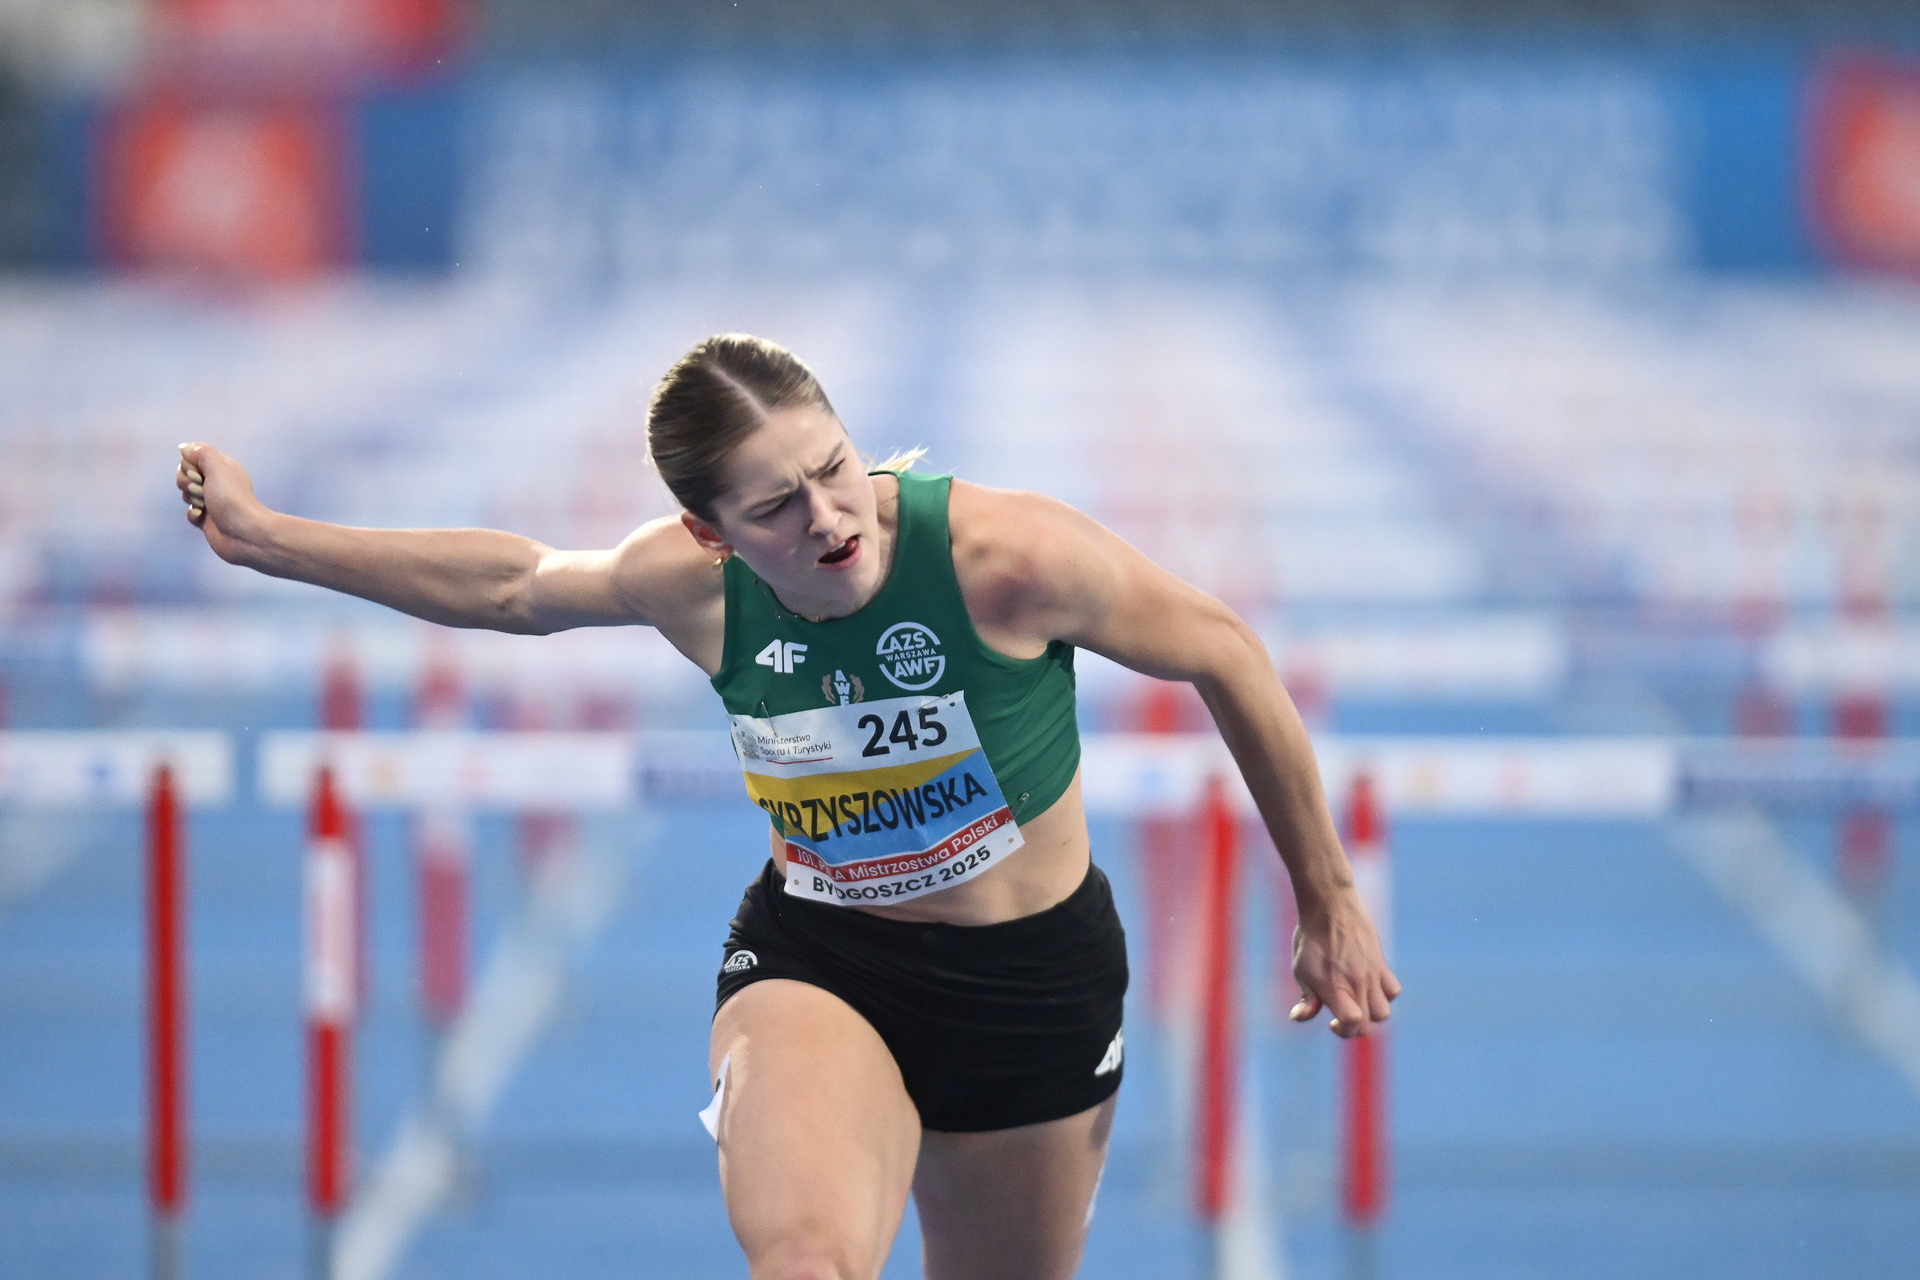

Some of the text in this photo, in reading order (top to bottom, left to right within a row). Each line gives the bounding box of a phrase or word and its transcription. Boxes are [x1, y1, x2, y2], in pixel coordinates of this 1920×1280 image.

[889, 631, 926, 651] AZS
[755, 639, 808, 674] 4F
[885, 648, 937, 662] WARSZAWA
[894, 656, 936, 678] AWF
[757, 734, 811, 745] Ministerstwo
[857, 706, 948, 758] 245
[793, 741, 832, 754] Turystyki
[848, 847, 951, 880] Mistrzostwa
[951, 814, 999, 851] Polski
[813, 845, 991, 900] BYDGOSZCZ 2025
[728, 955, 749, 967] AZS
